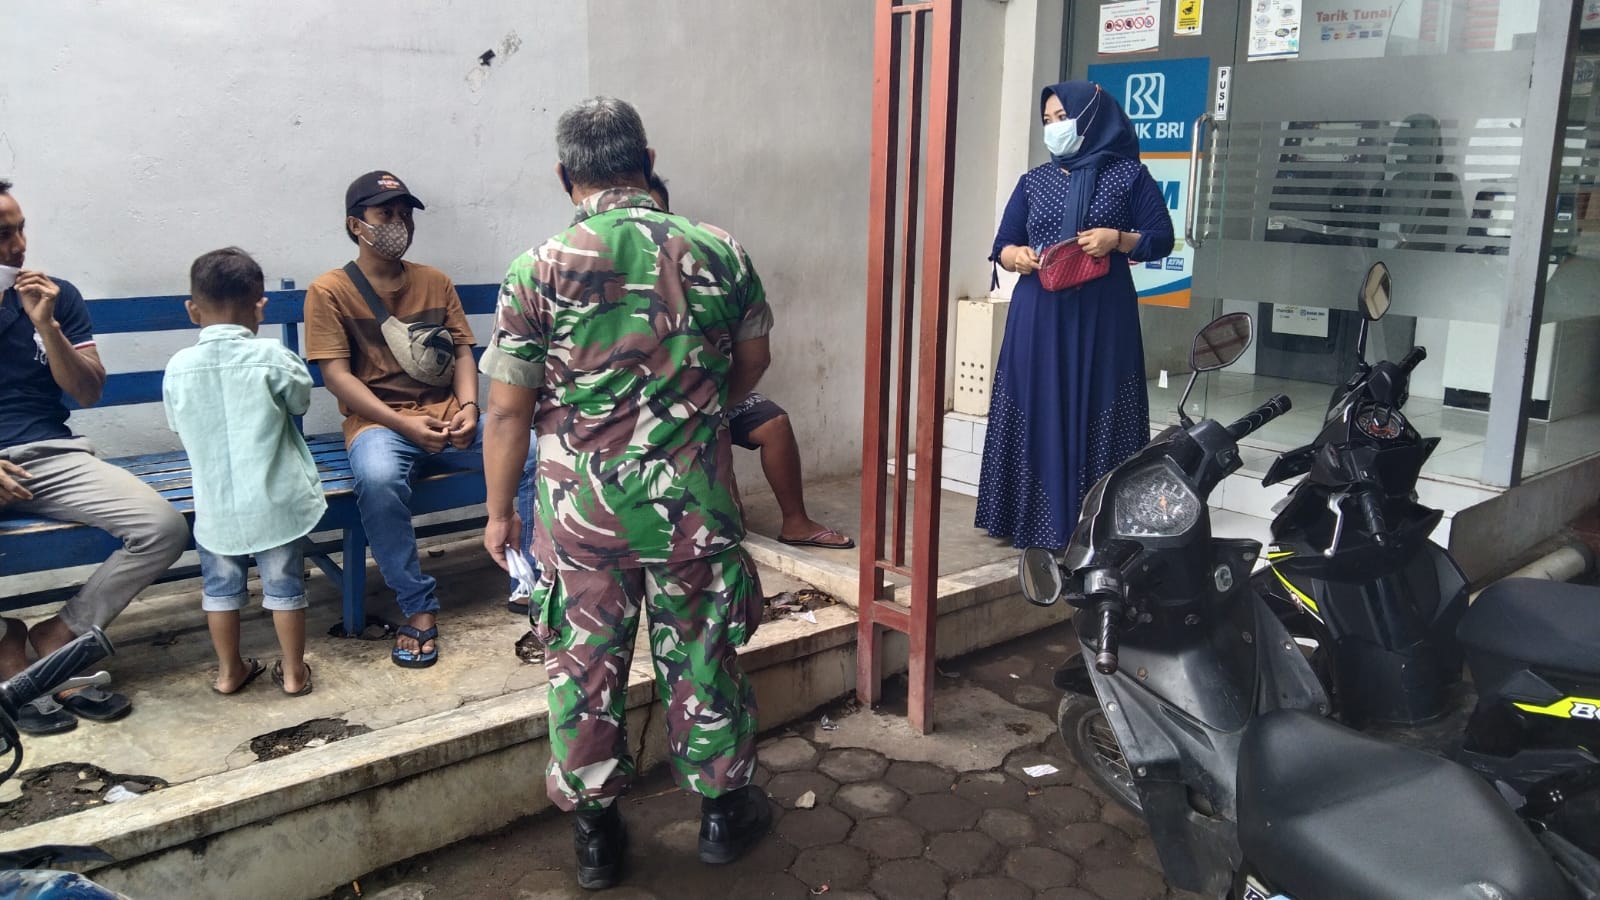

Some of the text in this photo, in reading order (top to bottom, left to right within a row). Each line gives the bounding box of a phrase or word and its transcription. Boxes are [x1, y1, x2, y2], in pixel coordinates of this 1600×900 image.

[1316, 6, 1393, 23] Tarik Tunai
[1217, 69, 1227, 112] PUSH
[1155, 121, 1185, 139] BRI
